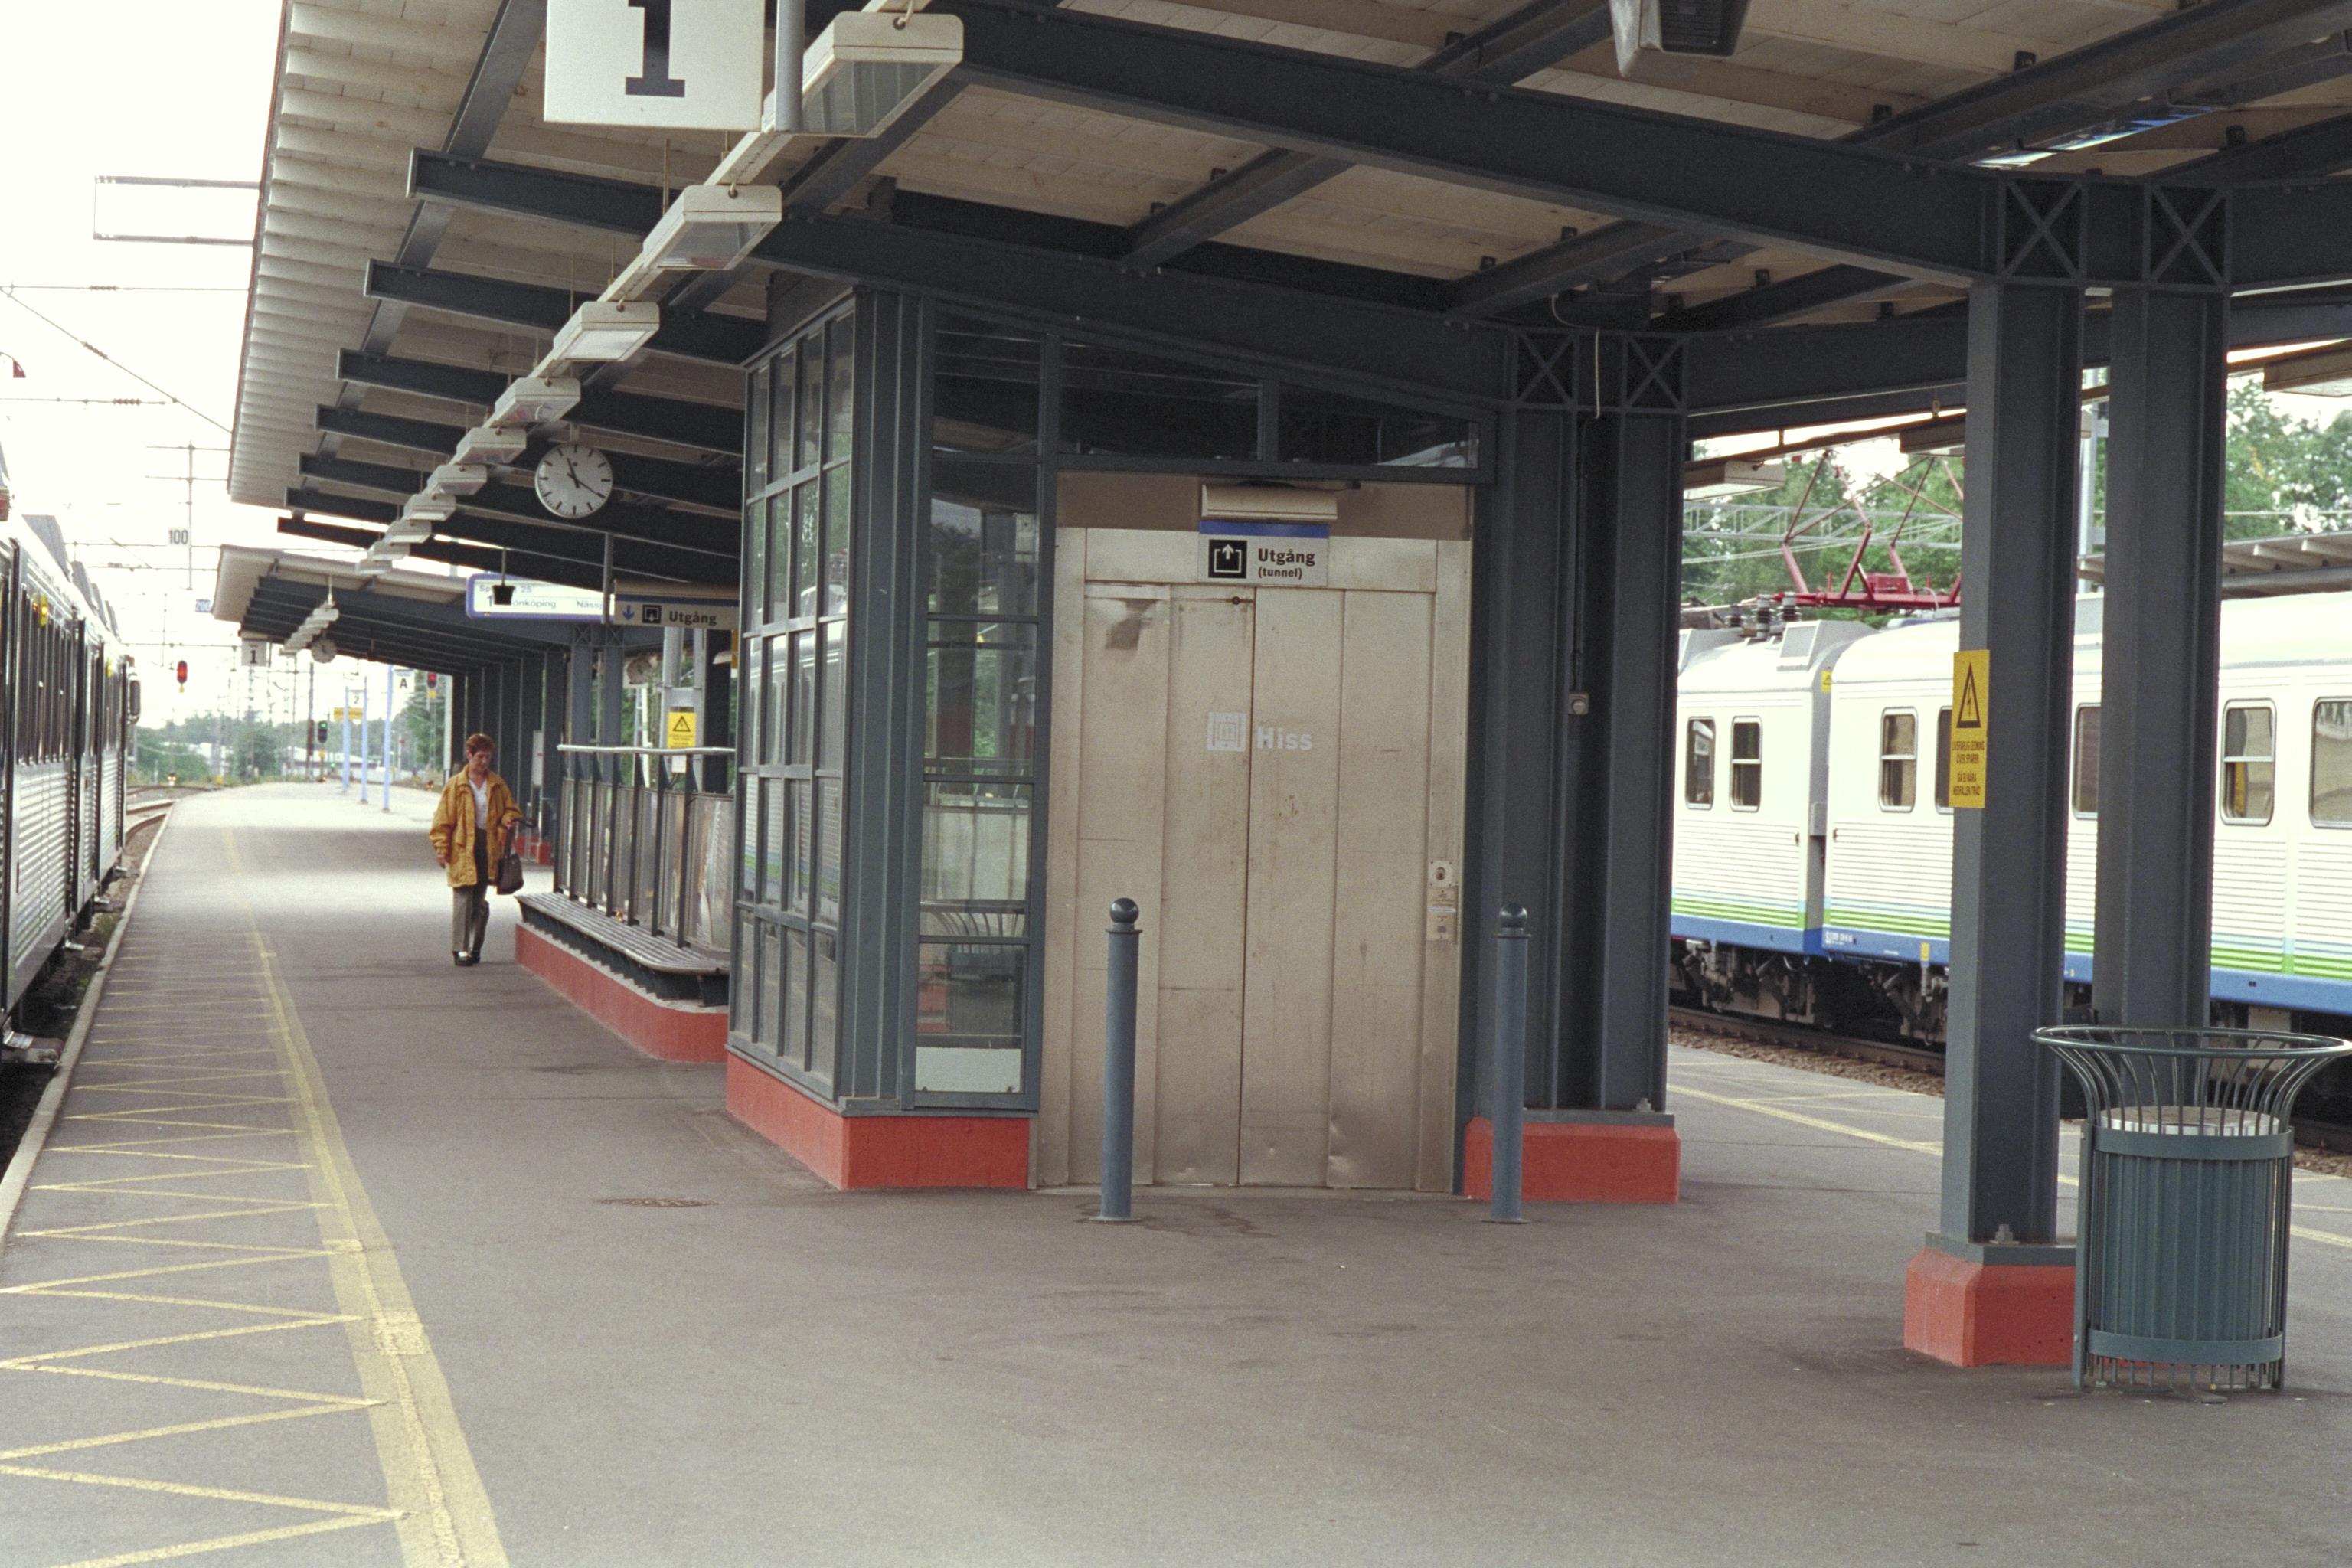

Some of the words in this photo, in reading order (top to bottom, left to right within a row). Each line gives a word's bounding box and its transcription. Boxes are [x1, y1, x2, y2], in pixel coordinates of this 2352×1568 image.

[626, 0, 685, 98] 1
[169, 529, 188, 545] 100
[1258, 548, 1315, 567] Utgång
[1258, 566, 1302, 580] (tunnel)
[512, 596, 557, 609] önköping
[576, 599, 603, 610] Näss
[668, 611, 717, 626] Utgång
[250, 649, 258, 664] 1
[399, 678, 408, 689] A
[1257, 727, 1312, 750] Hiss
